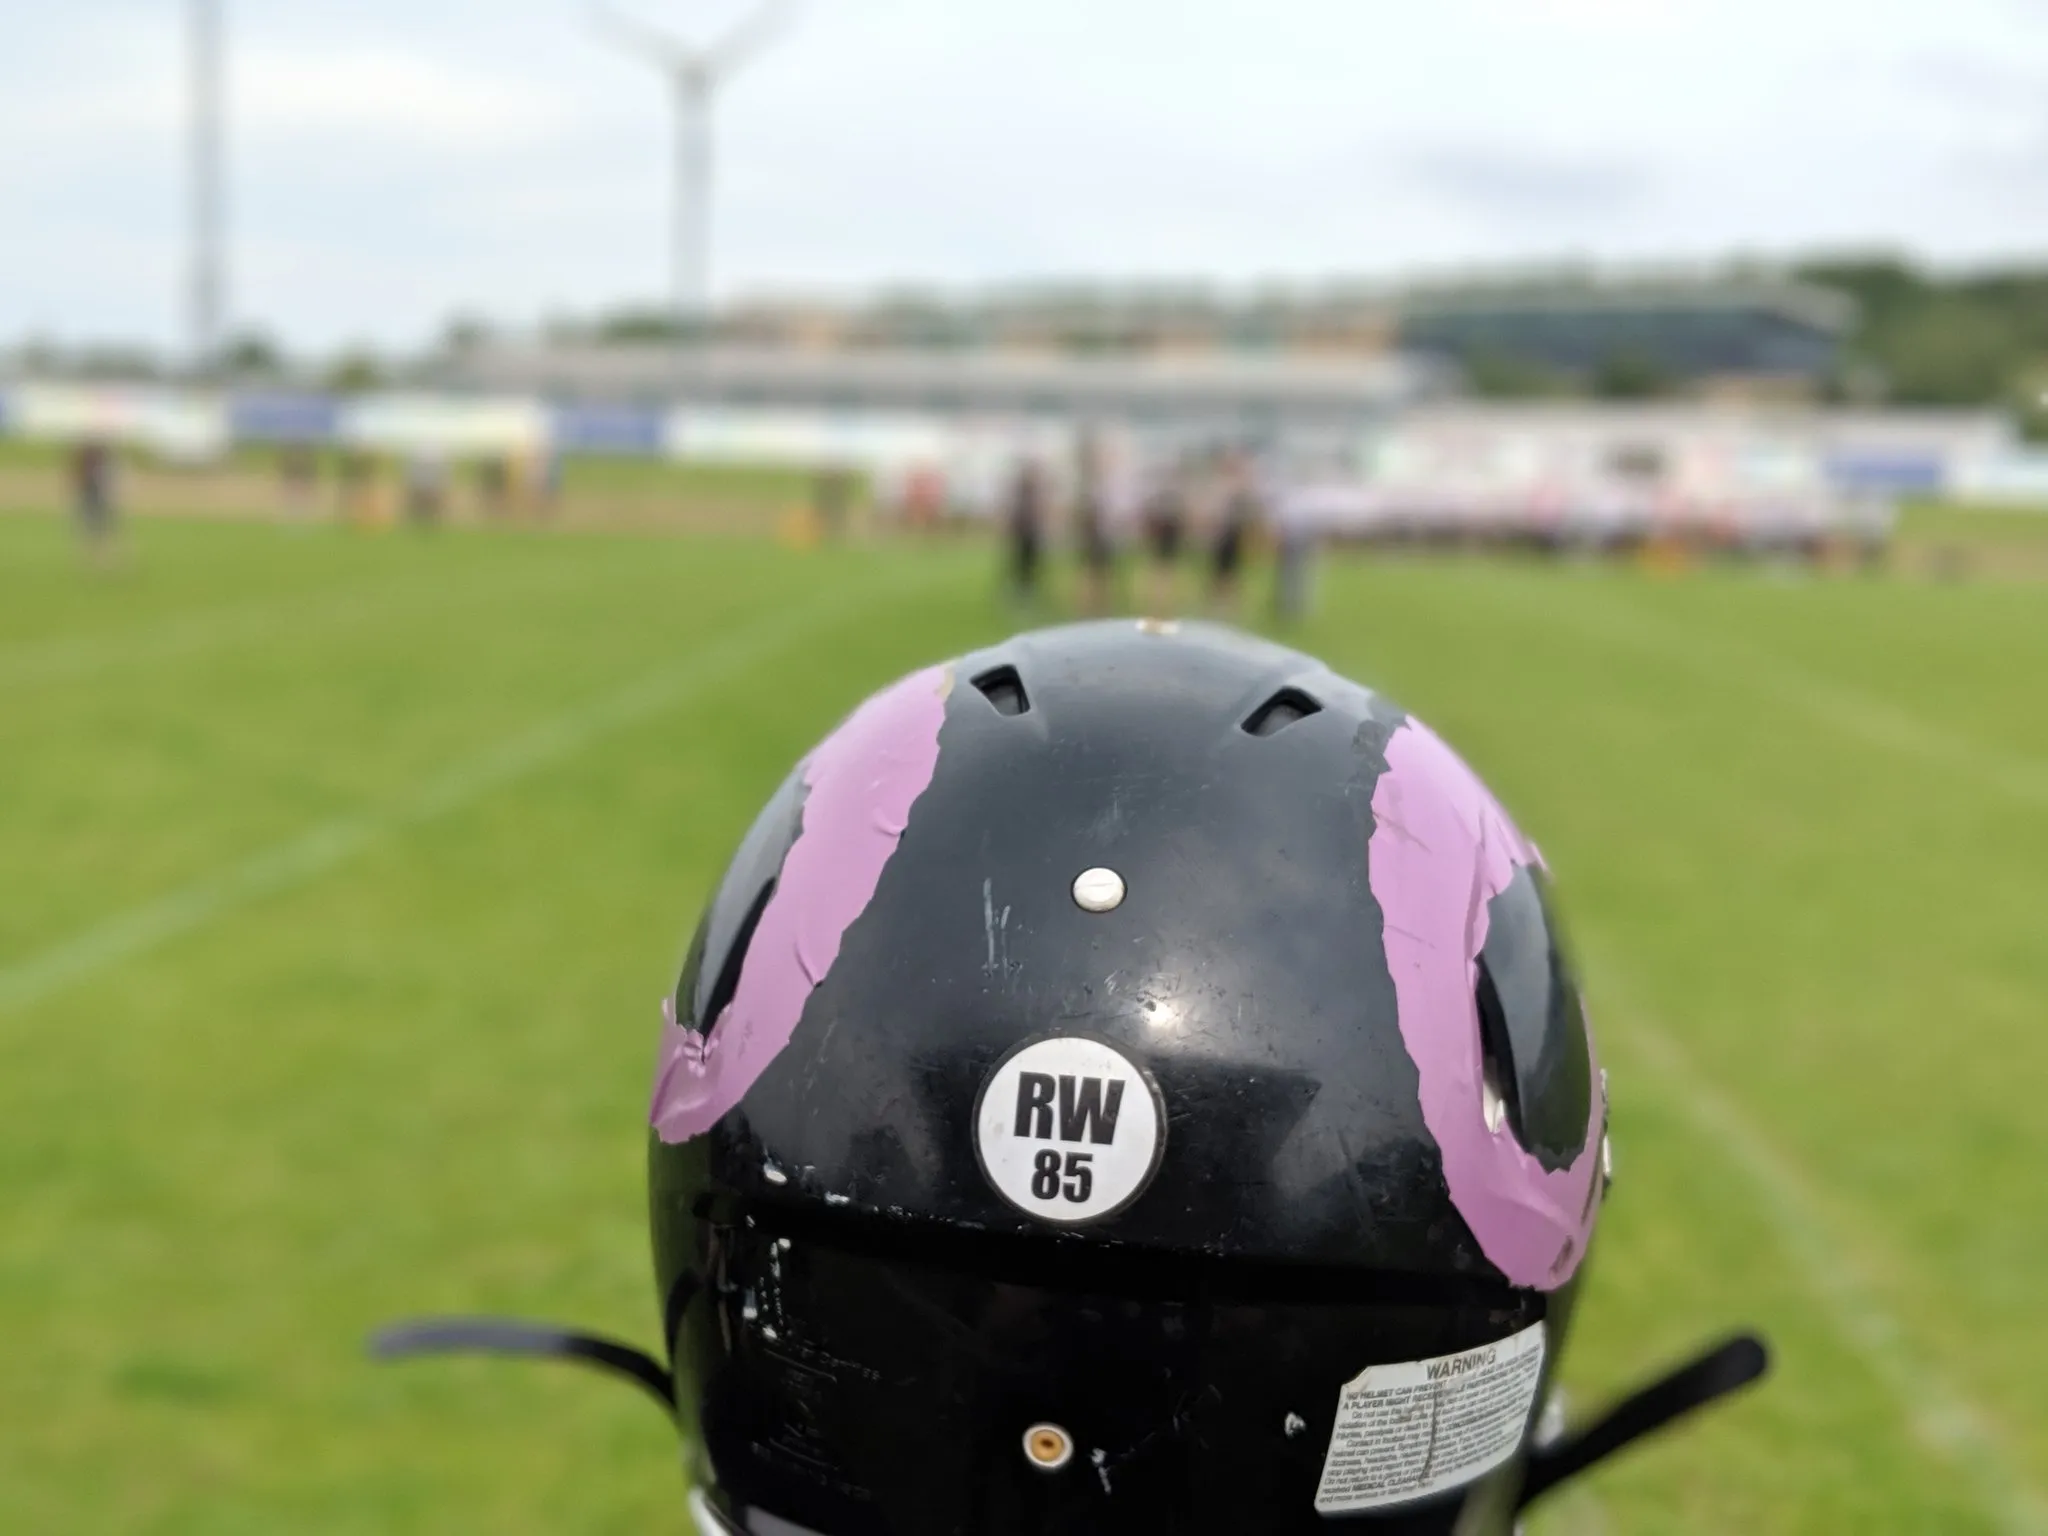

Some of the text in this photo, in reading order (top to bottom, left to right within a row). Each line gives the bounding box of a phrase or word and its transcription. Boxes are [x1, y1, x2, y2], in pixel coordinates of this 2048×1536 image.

[1013, 1071, 1126, 1145] RW
[1030, 1148, 1094, 1204] 85
[1426, 1348, 1497, 1380] WARNING
[1350, 1399, 1384, 1409] PLAYER
